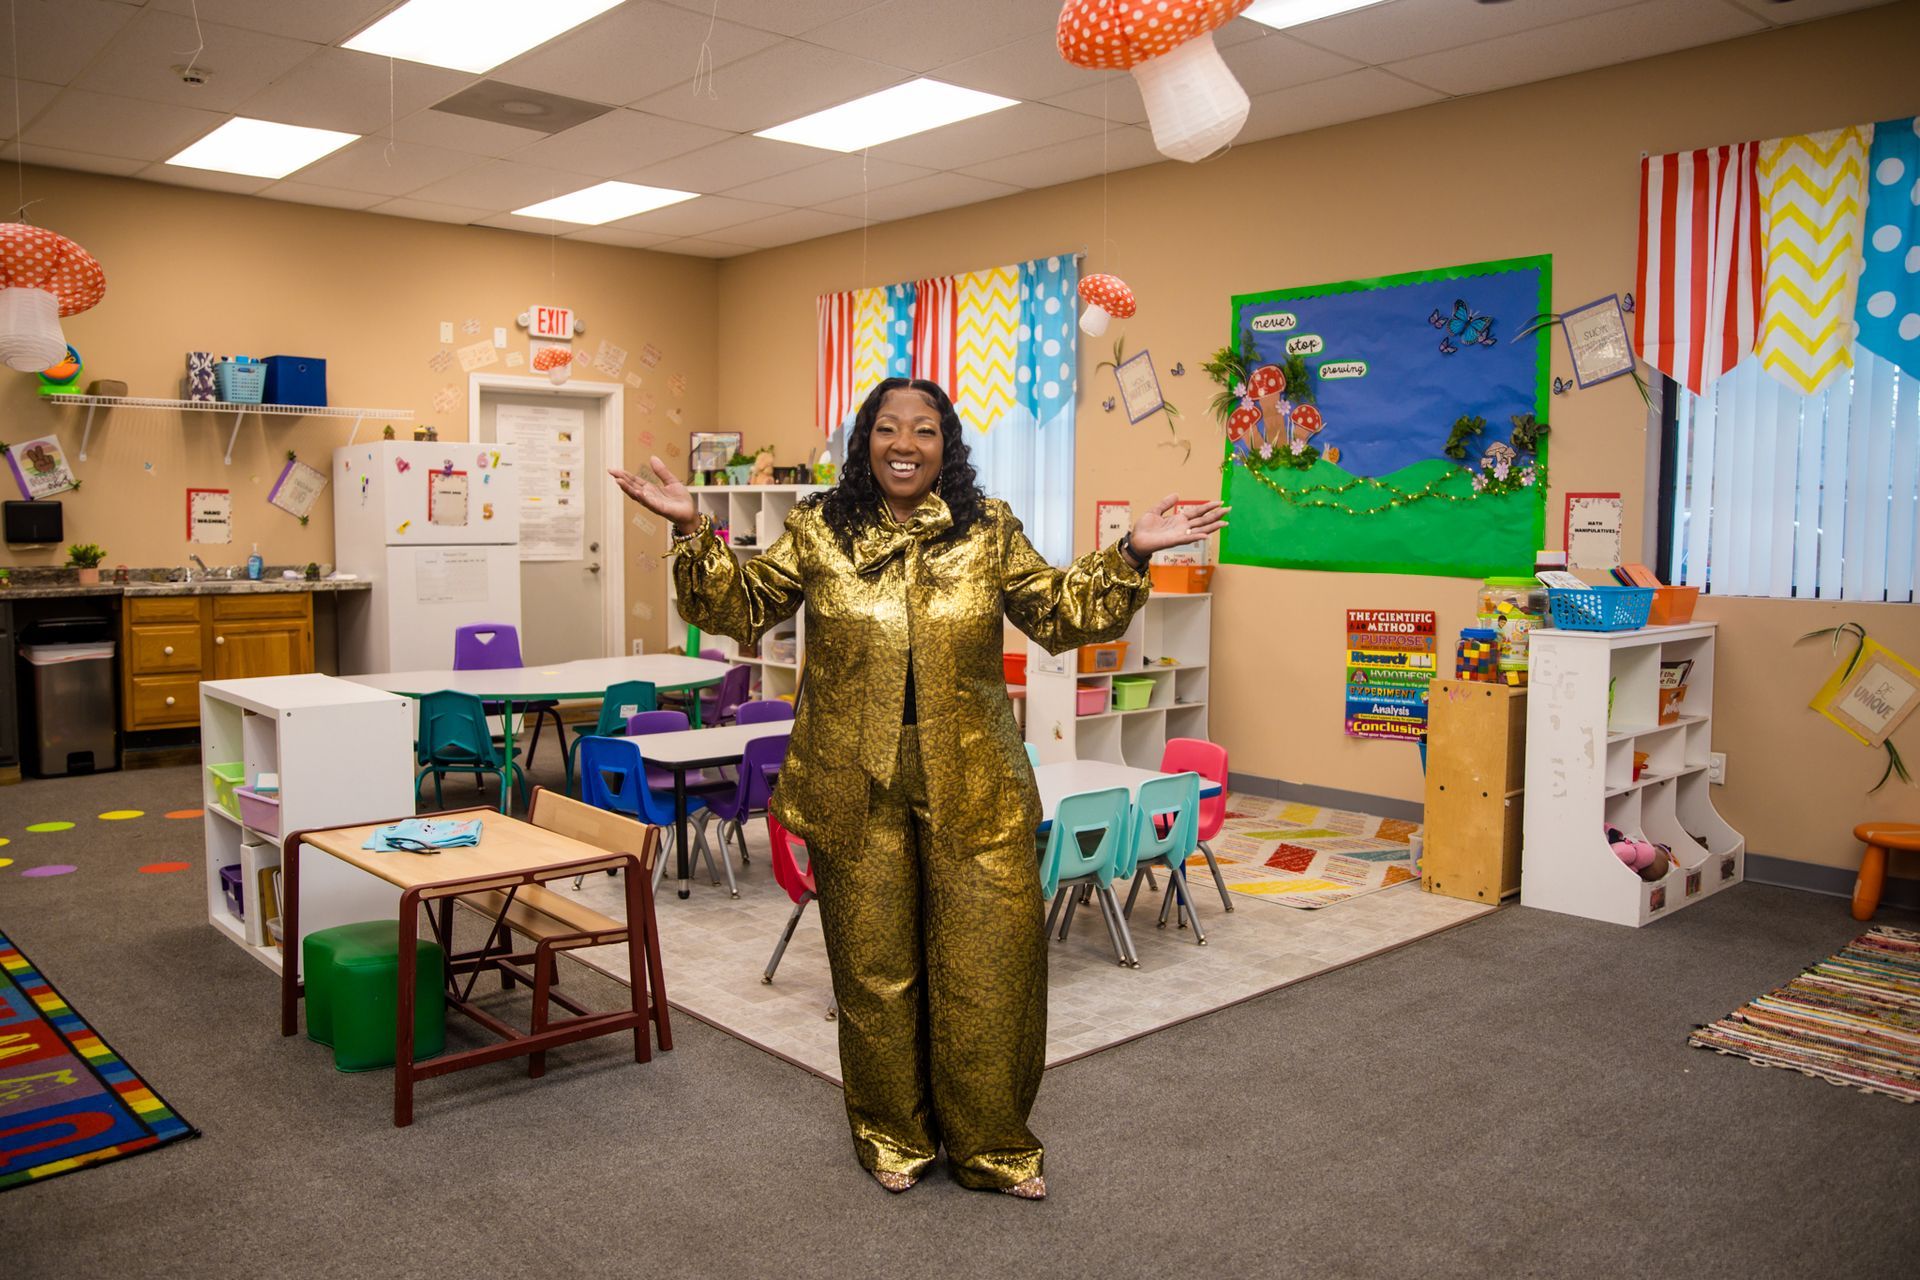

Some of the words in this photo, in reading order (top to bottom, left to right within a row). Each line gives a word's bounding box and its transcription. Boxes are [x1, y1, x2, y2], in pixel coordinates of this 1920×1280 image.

[538, 308, 568, 336] EXIT
[1254, 315, 1295, 329] never
[1288, 338, 1320, 353] stop
[1321, 364, 1365, 377] growing
[1349, 611, 1370, 621] THE
[1371, 611, 1432, 623] SCIENTIFIC
[1367, 622, 1415, 633] METHOD
[1360, 633, 1424, 647] PURPOSE
[1351, 651, 1408, 665] Research
[1349, 686, 1417, 698] EXPERIMENT
[1874, 681, 1896, 701] BE
[1372, 703, 1410, 716] Analysis
[1854, 686, 1895, 720] UNIQUE
